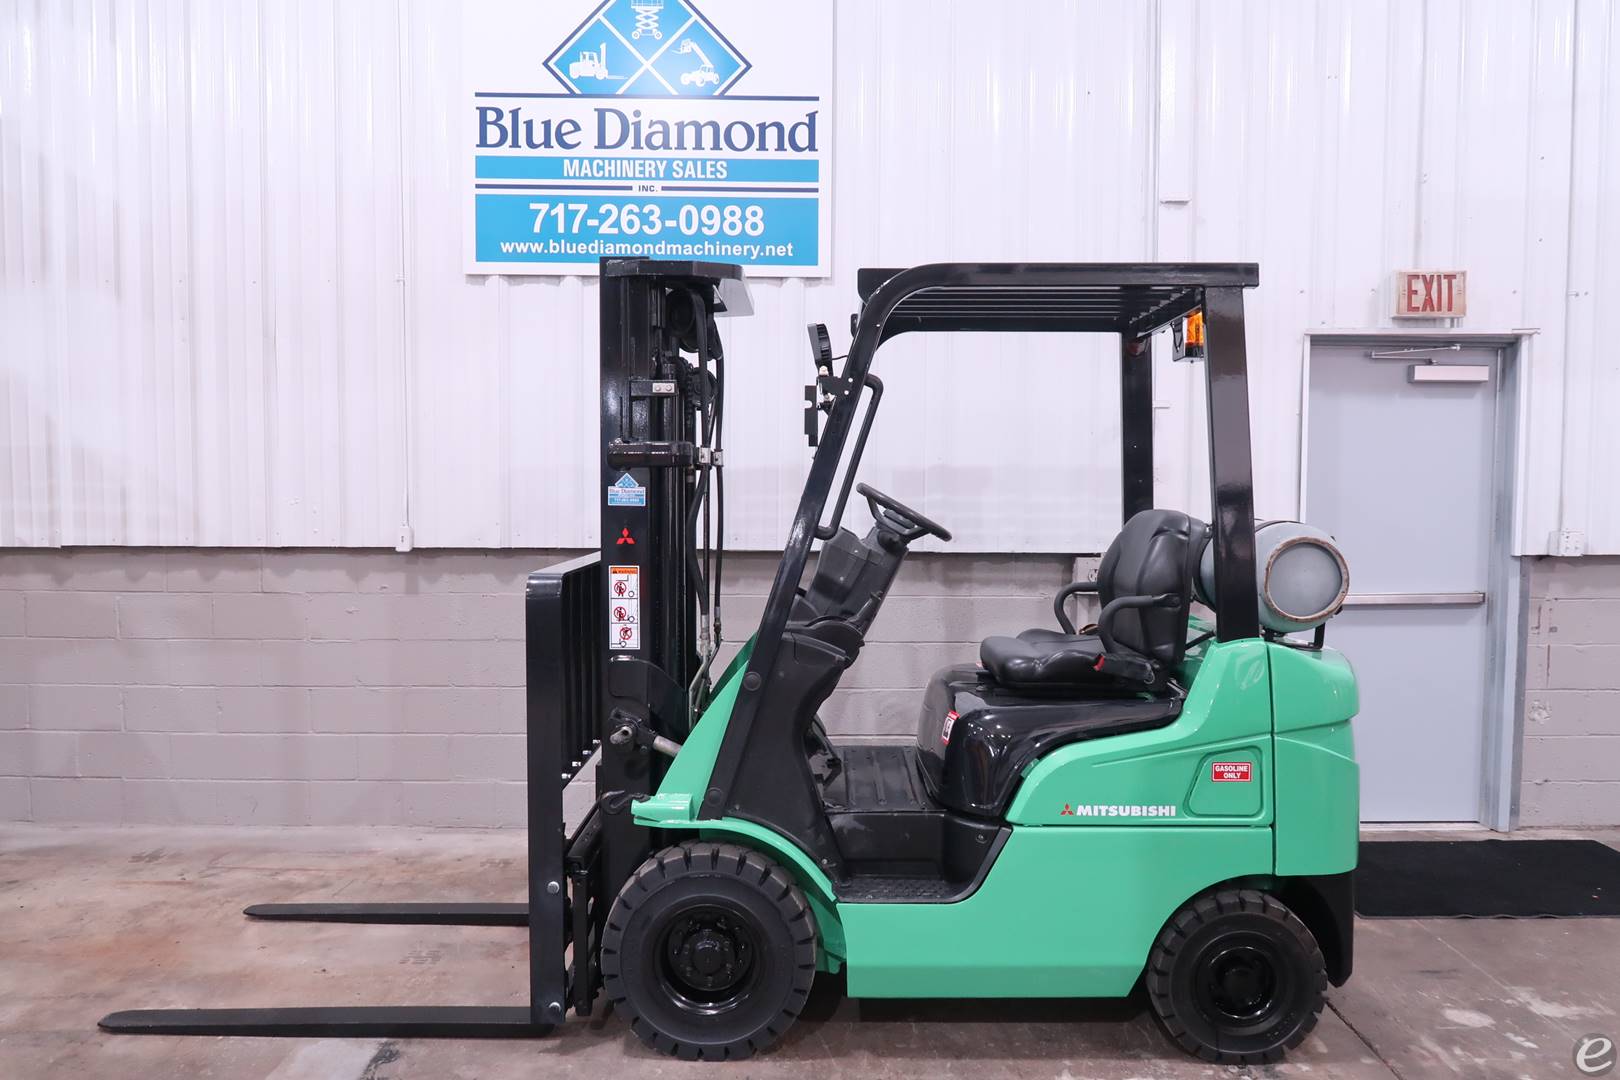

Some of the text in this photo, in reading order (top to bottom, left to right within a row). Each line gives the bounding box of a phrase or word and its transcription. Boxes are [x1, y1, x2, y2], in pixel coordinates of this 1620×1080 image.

[475, 106, 819, 152] Blue Diamond
[563, 159, 728, 180] MACHINERY SALES
[638, 184, 658, 192] INC.
[529, 202, 765, 236] 717-263-0988
[500, 239, 793, 258] www.bluediamondmachinery.net
[1407, 274, 1457, 312] EXIT
[1076, 805, 1177, 817] MITSUBISHI
